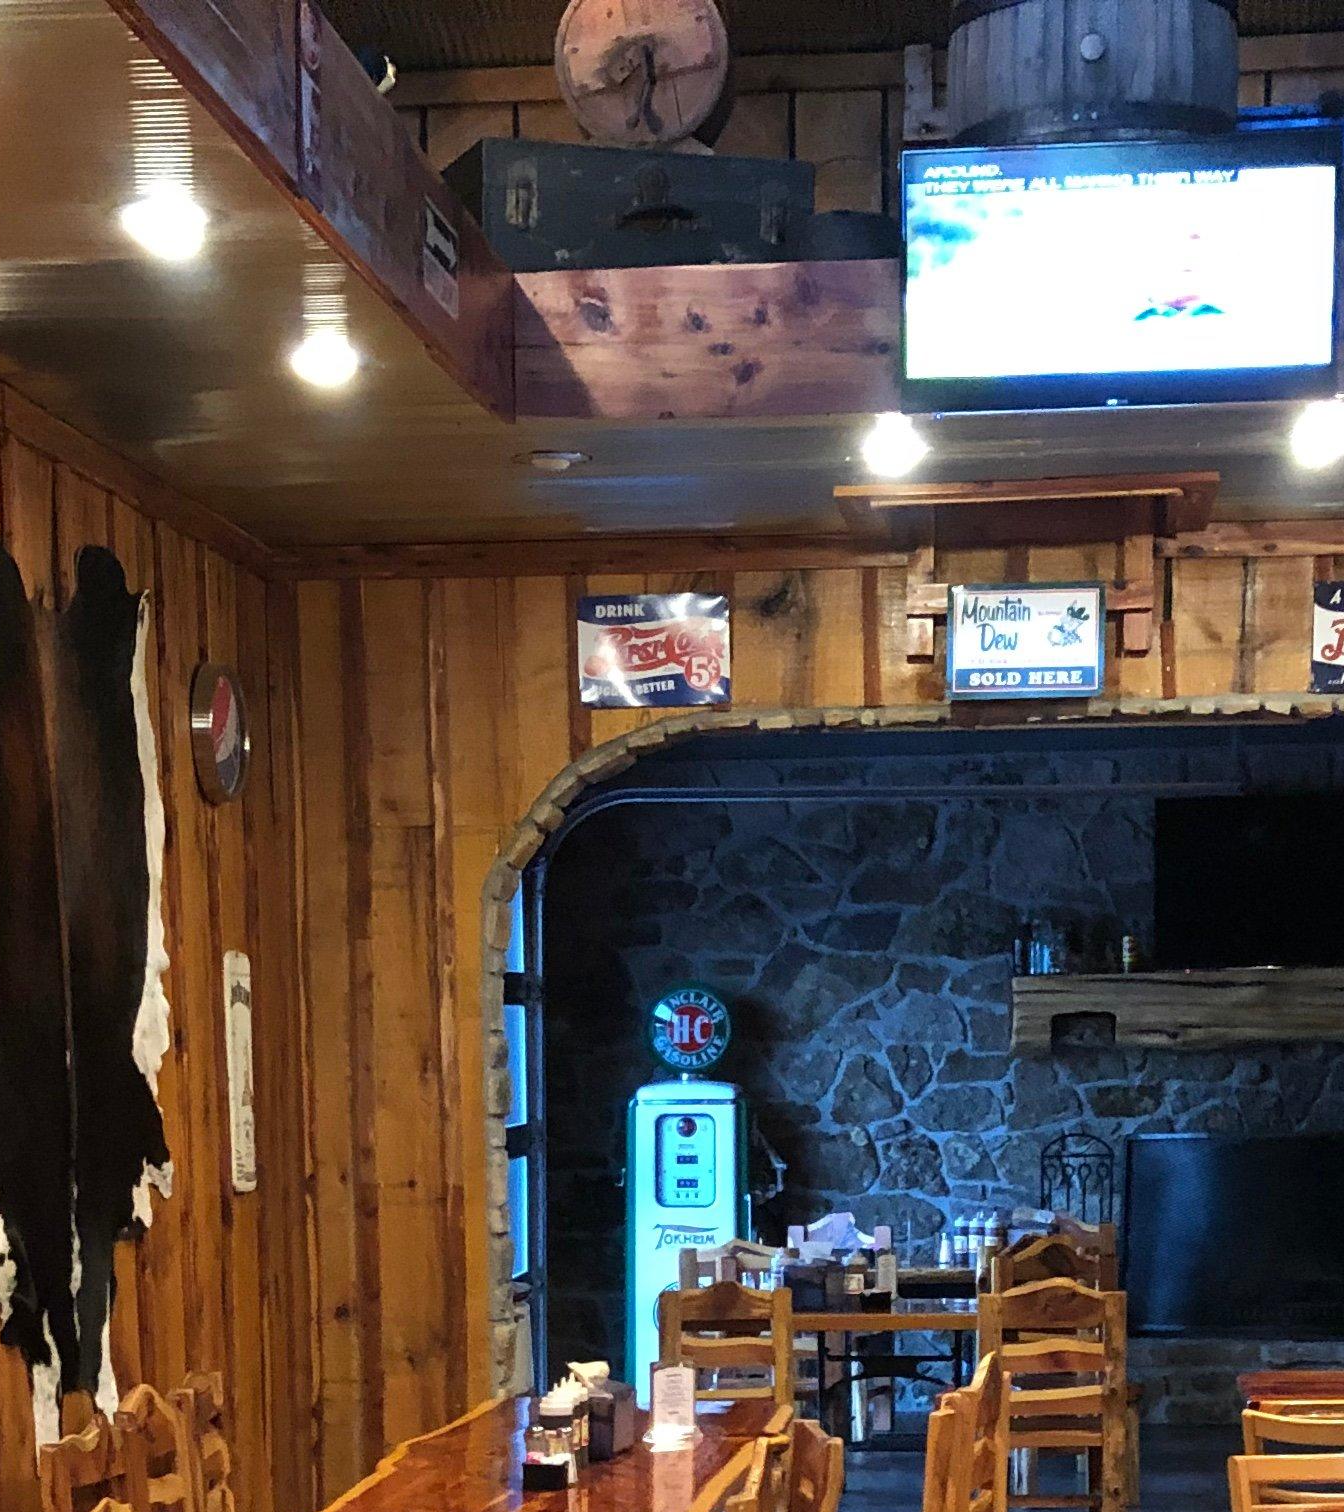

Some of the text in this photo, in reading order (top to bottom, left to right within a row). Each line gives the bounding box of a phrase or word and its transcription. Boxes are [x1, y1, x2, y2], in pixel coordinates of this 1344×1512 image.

[1330, 589, 1342, 604] A
[595, 603, 645, 618] DRINK
[961, 596, 1031, 624] Mountain
[976, 622, 1018, 651] Dew
[635, 679, 676, 695] BETTER
[969, 670, 1083, 687] SOLD HERE
[655, 991, 725, 1026] NCLAIR
[653, 1223, 719, 1250] TOKHEIM
